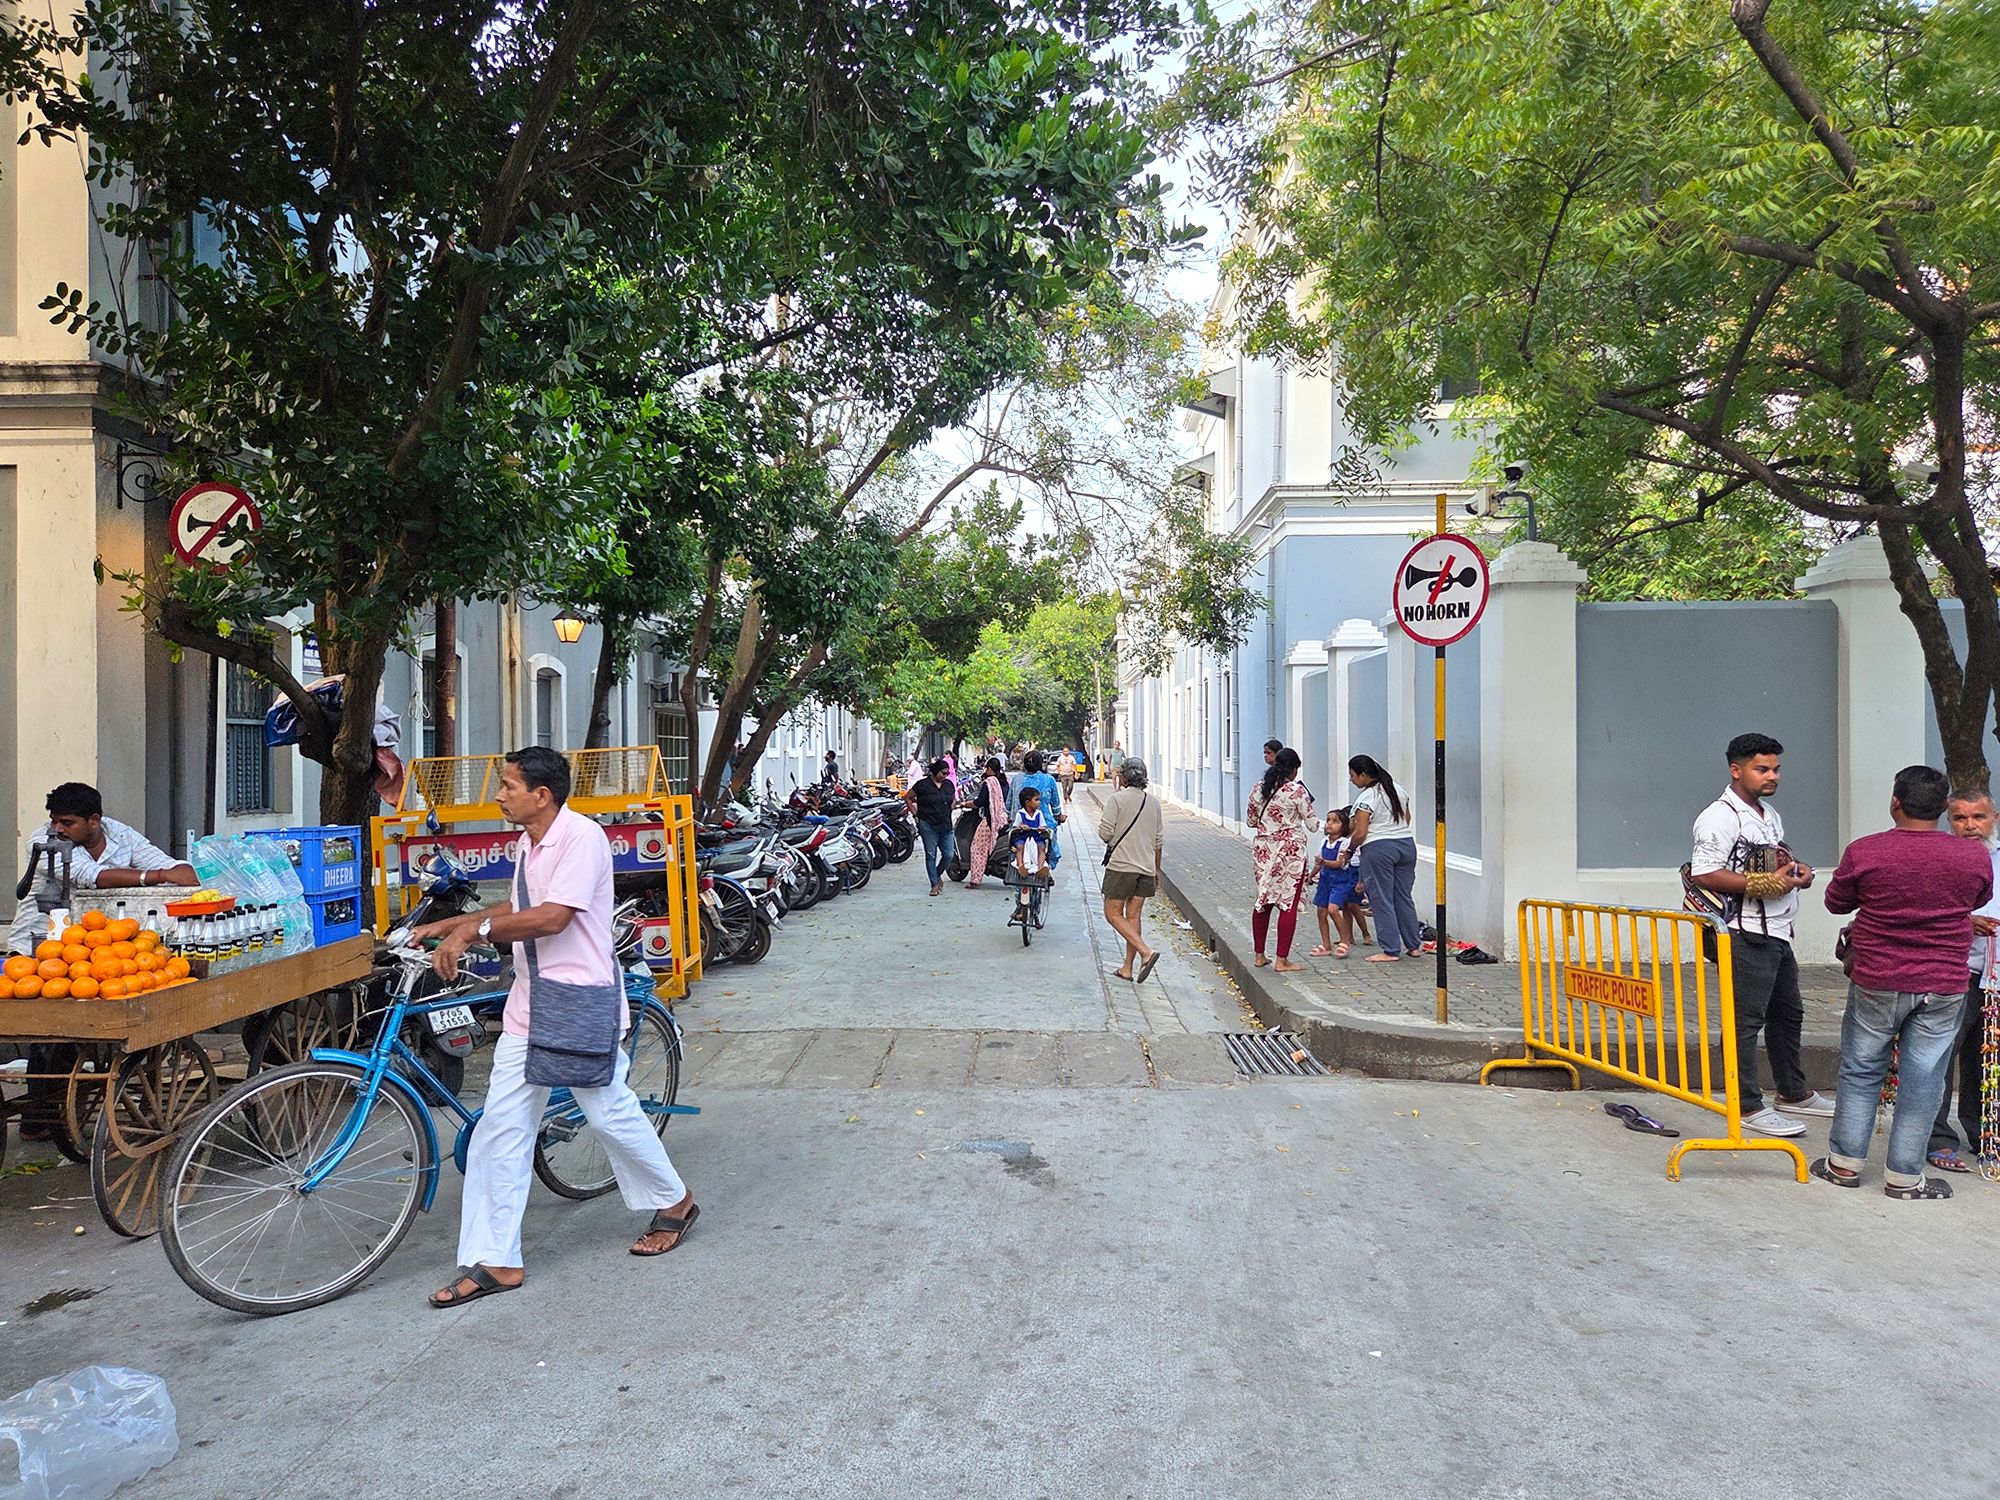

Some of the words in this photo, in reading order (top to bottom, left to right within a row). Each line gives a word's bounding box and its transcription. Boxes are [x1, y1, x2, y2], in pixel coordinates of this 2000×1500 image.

[1404, 605, 1424, 622] NO
[1426, 601, 1470, 621] HORN
[324, 866, 354, 887] DHEERA
[1571, 973, 1609, 1001] TRAFFIC
[1611, 980, 1648, 1010] POLICE
[440, 1015, 470, 1028] S1558
